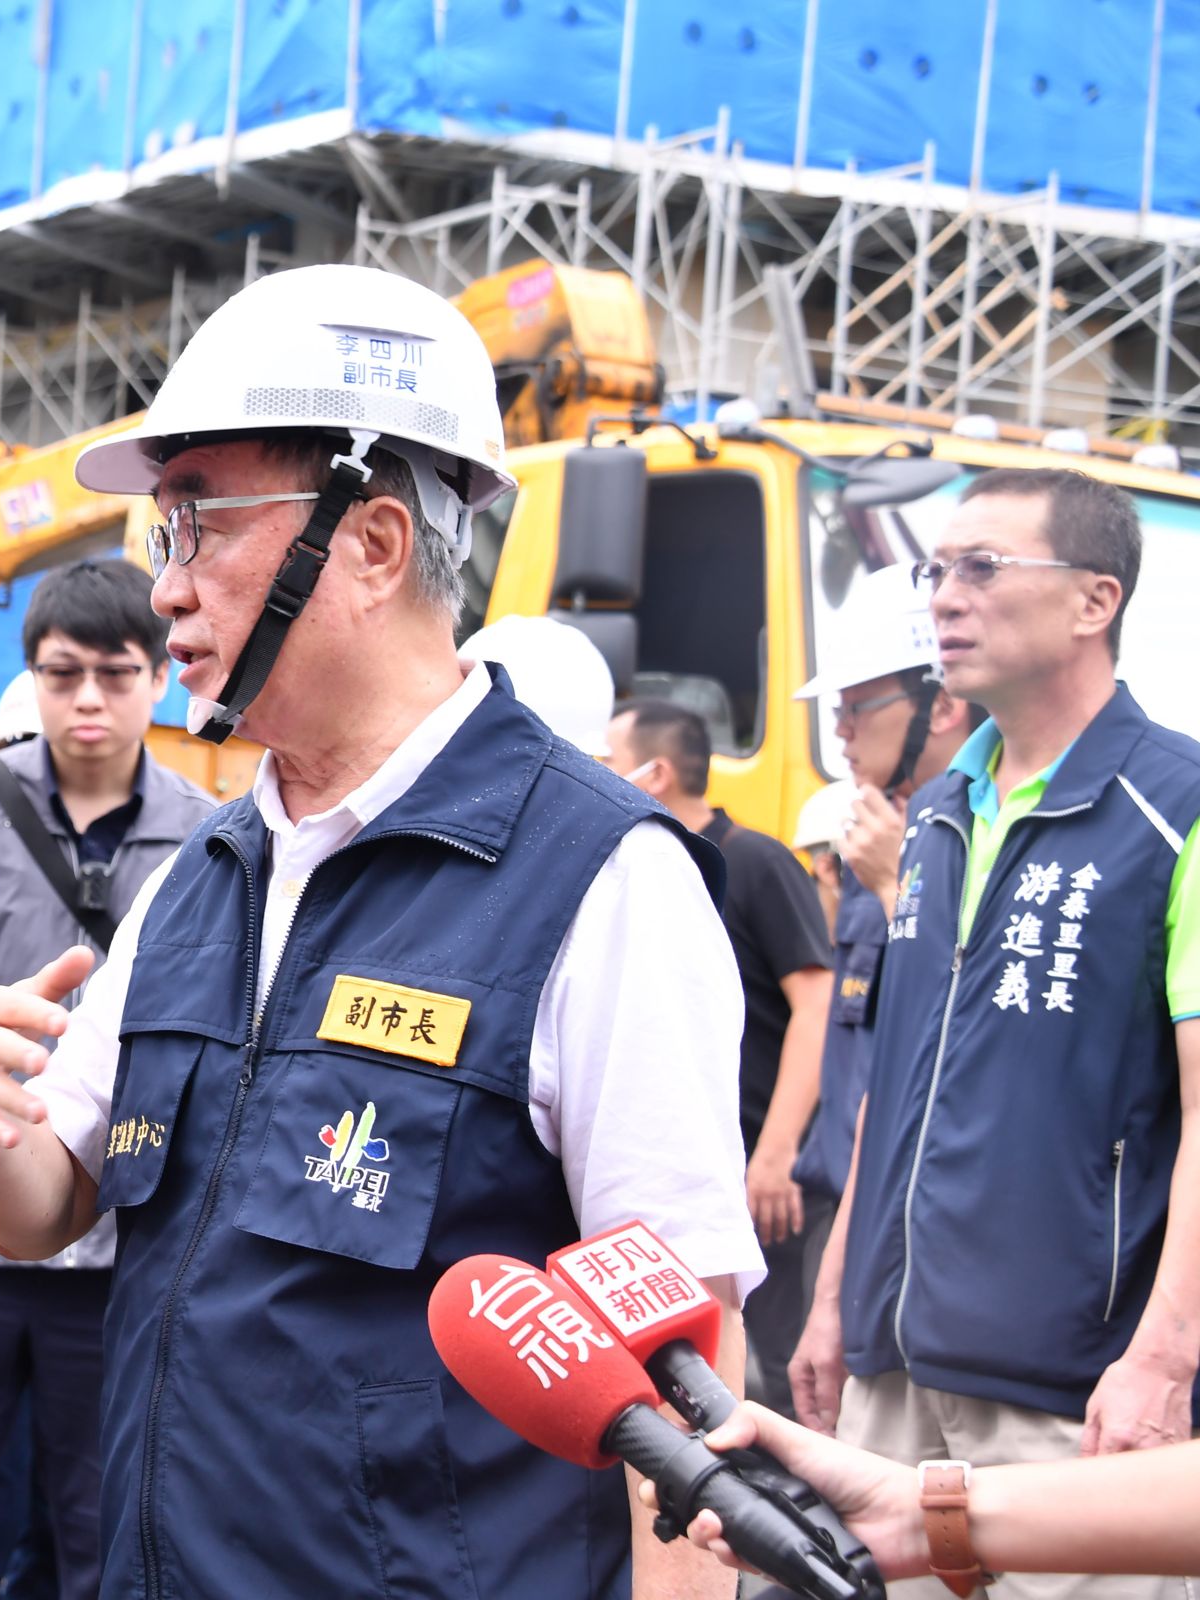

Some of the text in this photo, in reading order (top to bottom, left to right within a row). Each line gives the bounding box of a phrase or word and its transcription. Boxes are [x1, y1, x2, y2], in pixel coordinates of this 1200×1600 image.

[336, 334, 423, 367] 李四川
[343, 361, 418, 394] 副市長
[992, 861, 1063, 1014] 游進義
[345, 996, 437, 1045] 副市長
[304, 1155, 390, 1197] TAIPEI
[575, 1237, 662, 1285] 非凡
[605, 1267, 695, 1322] 新聞
[468, 1263, 614, 1389] 台視
